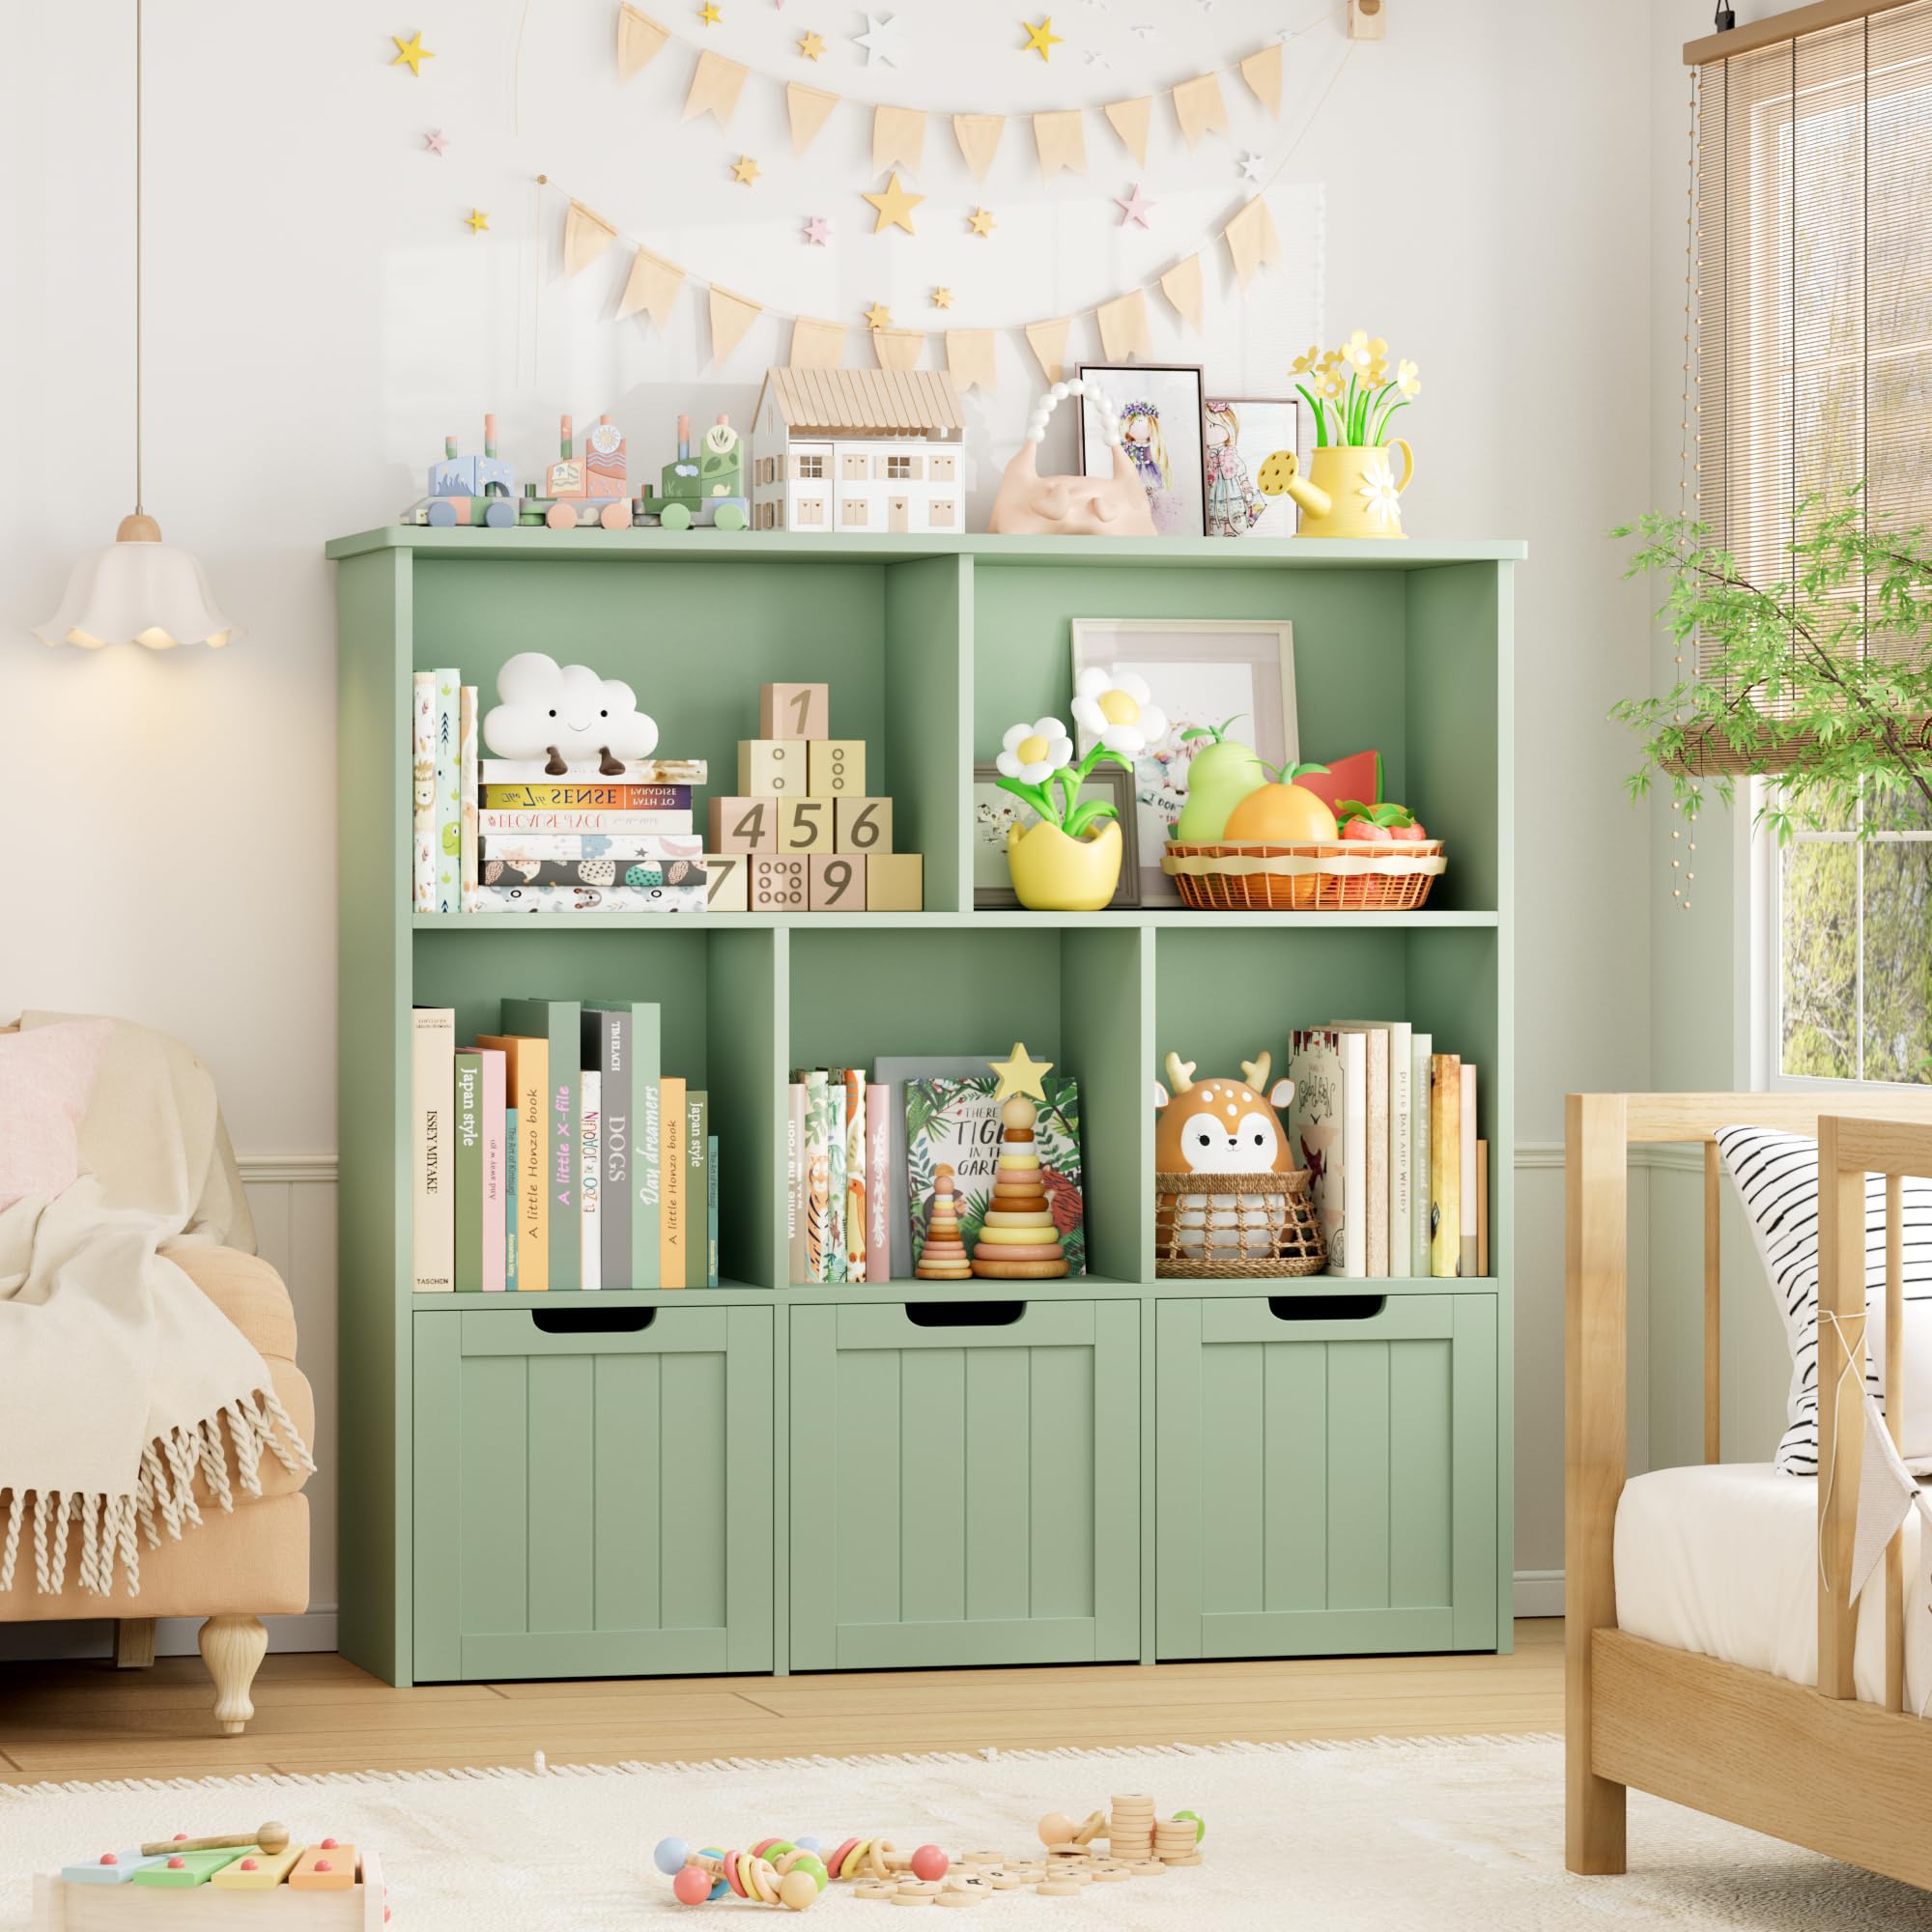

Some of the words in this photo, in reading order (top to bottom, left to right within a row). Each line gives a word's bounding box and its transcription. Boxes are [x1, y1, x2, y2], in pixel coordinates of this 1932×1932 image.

[789, 689, 811, 734] 1
[732, 803, 765, 848] 4
[789, 803, 822, 848] 5
[850, 803, 879, 848] 6
[706, 860, 736, 905] 7
[823, 860, 853, 905] 9
[459, 1067, 478, 1109] Japan
[526, 1089, 538, 1123] book
[427, 1110, 438, 1144] ISSEY
[459, 1113, 478, 1147] style
[636, 1086, 659, 1164] dreamers
[668, 1120, 677, 1150] book
[688, 1102, 703, 1137] Japan
[952, 1119, 1005, 1146] TIG
[1399, 1113, 1407, 1137] PAN
[528, 1130, 538, 1177] Honzo
[556, 1143, 570, 1183] little
[609, 1116, 626, 1182] DOGS
[688, 1140, 704, 1168] style
[969, 1147, 981, 1158] IN
[427, 1146, 438, 1195] MIYAKE
[639, 1167, 661, 1206] Day
[668, 1154, 677, 1194] Honzo
[527, 1185, 538, 1219] little
[557, 1190, 570, 1206] A
[582, 1204, 595, 1212] EL
[1399, 1171, 1407, 1214] WENDY
[528, 1227, 538, 1238] A
[668, 1200, 677, 1230] little
[668, 1235, 677, 1244] A
